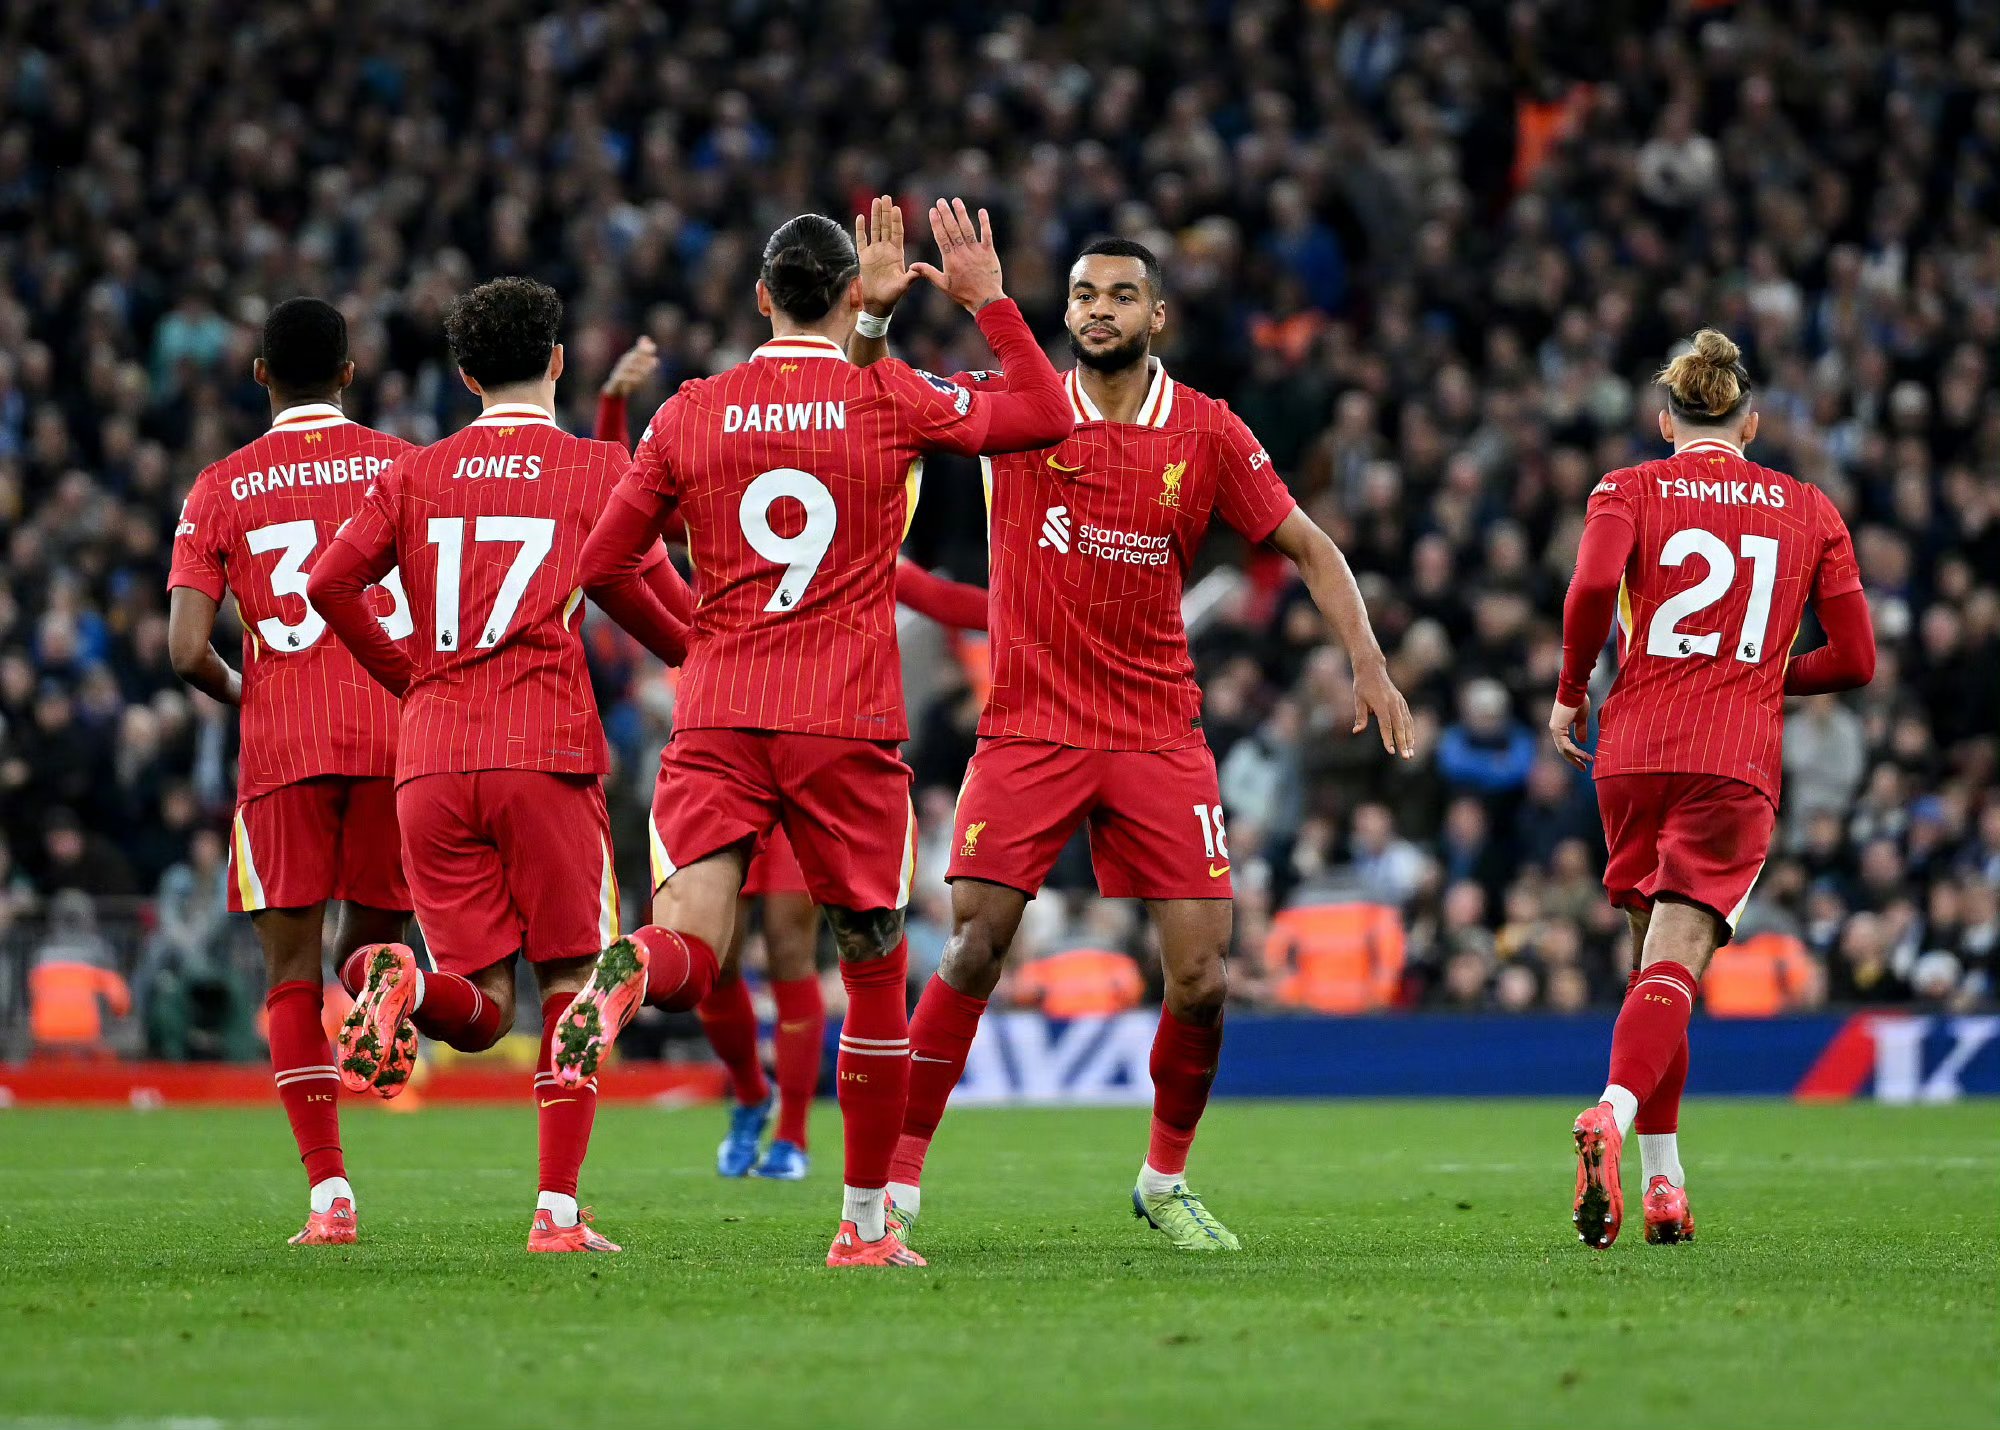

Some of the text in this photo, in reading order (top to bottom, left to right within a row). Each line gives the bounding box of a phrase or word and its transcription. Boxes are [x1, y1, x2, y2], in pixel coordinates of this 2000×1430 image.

[723, 400, 846, 433] DARWIN
[453, 454, 541, 480] JONES
[1656, 477, 1785, 508] TSIMIKAS
[739, 468, 837, 612] 9
[1079, 523, 1171, 549] standard
[1077, 541, 1170, 566] chartered
[428, 516, 555, 652] 17
[1647, 528, 1779, 663] 21
[1193, 804, 1229, 859] 18
[1643, 993, 1673, 1006] LFC
[841, 1070, 868, 1083] LFC
[306, 1094, 333, 1102] LFC
